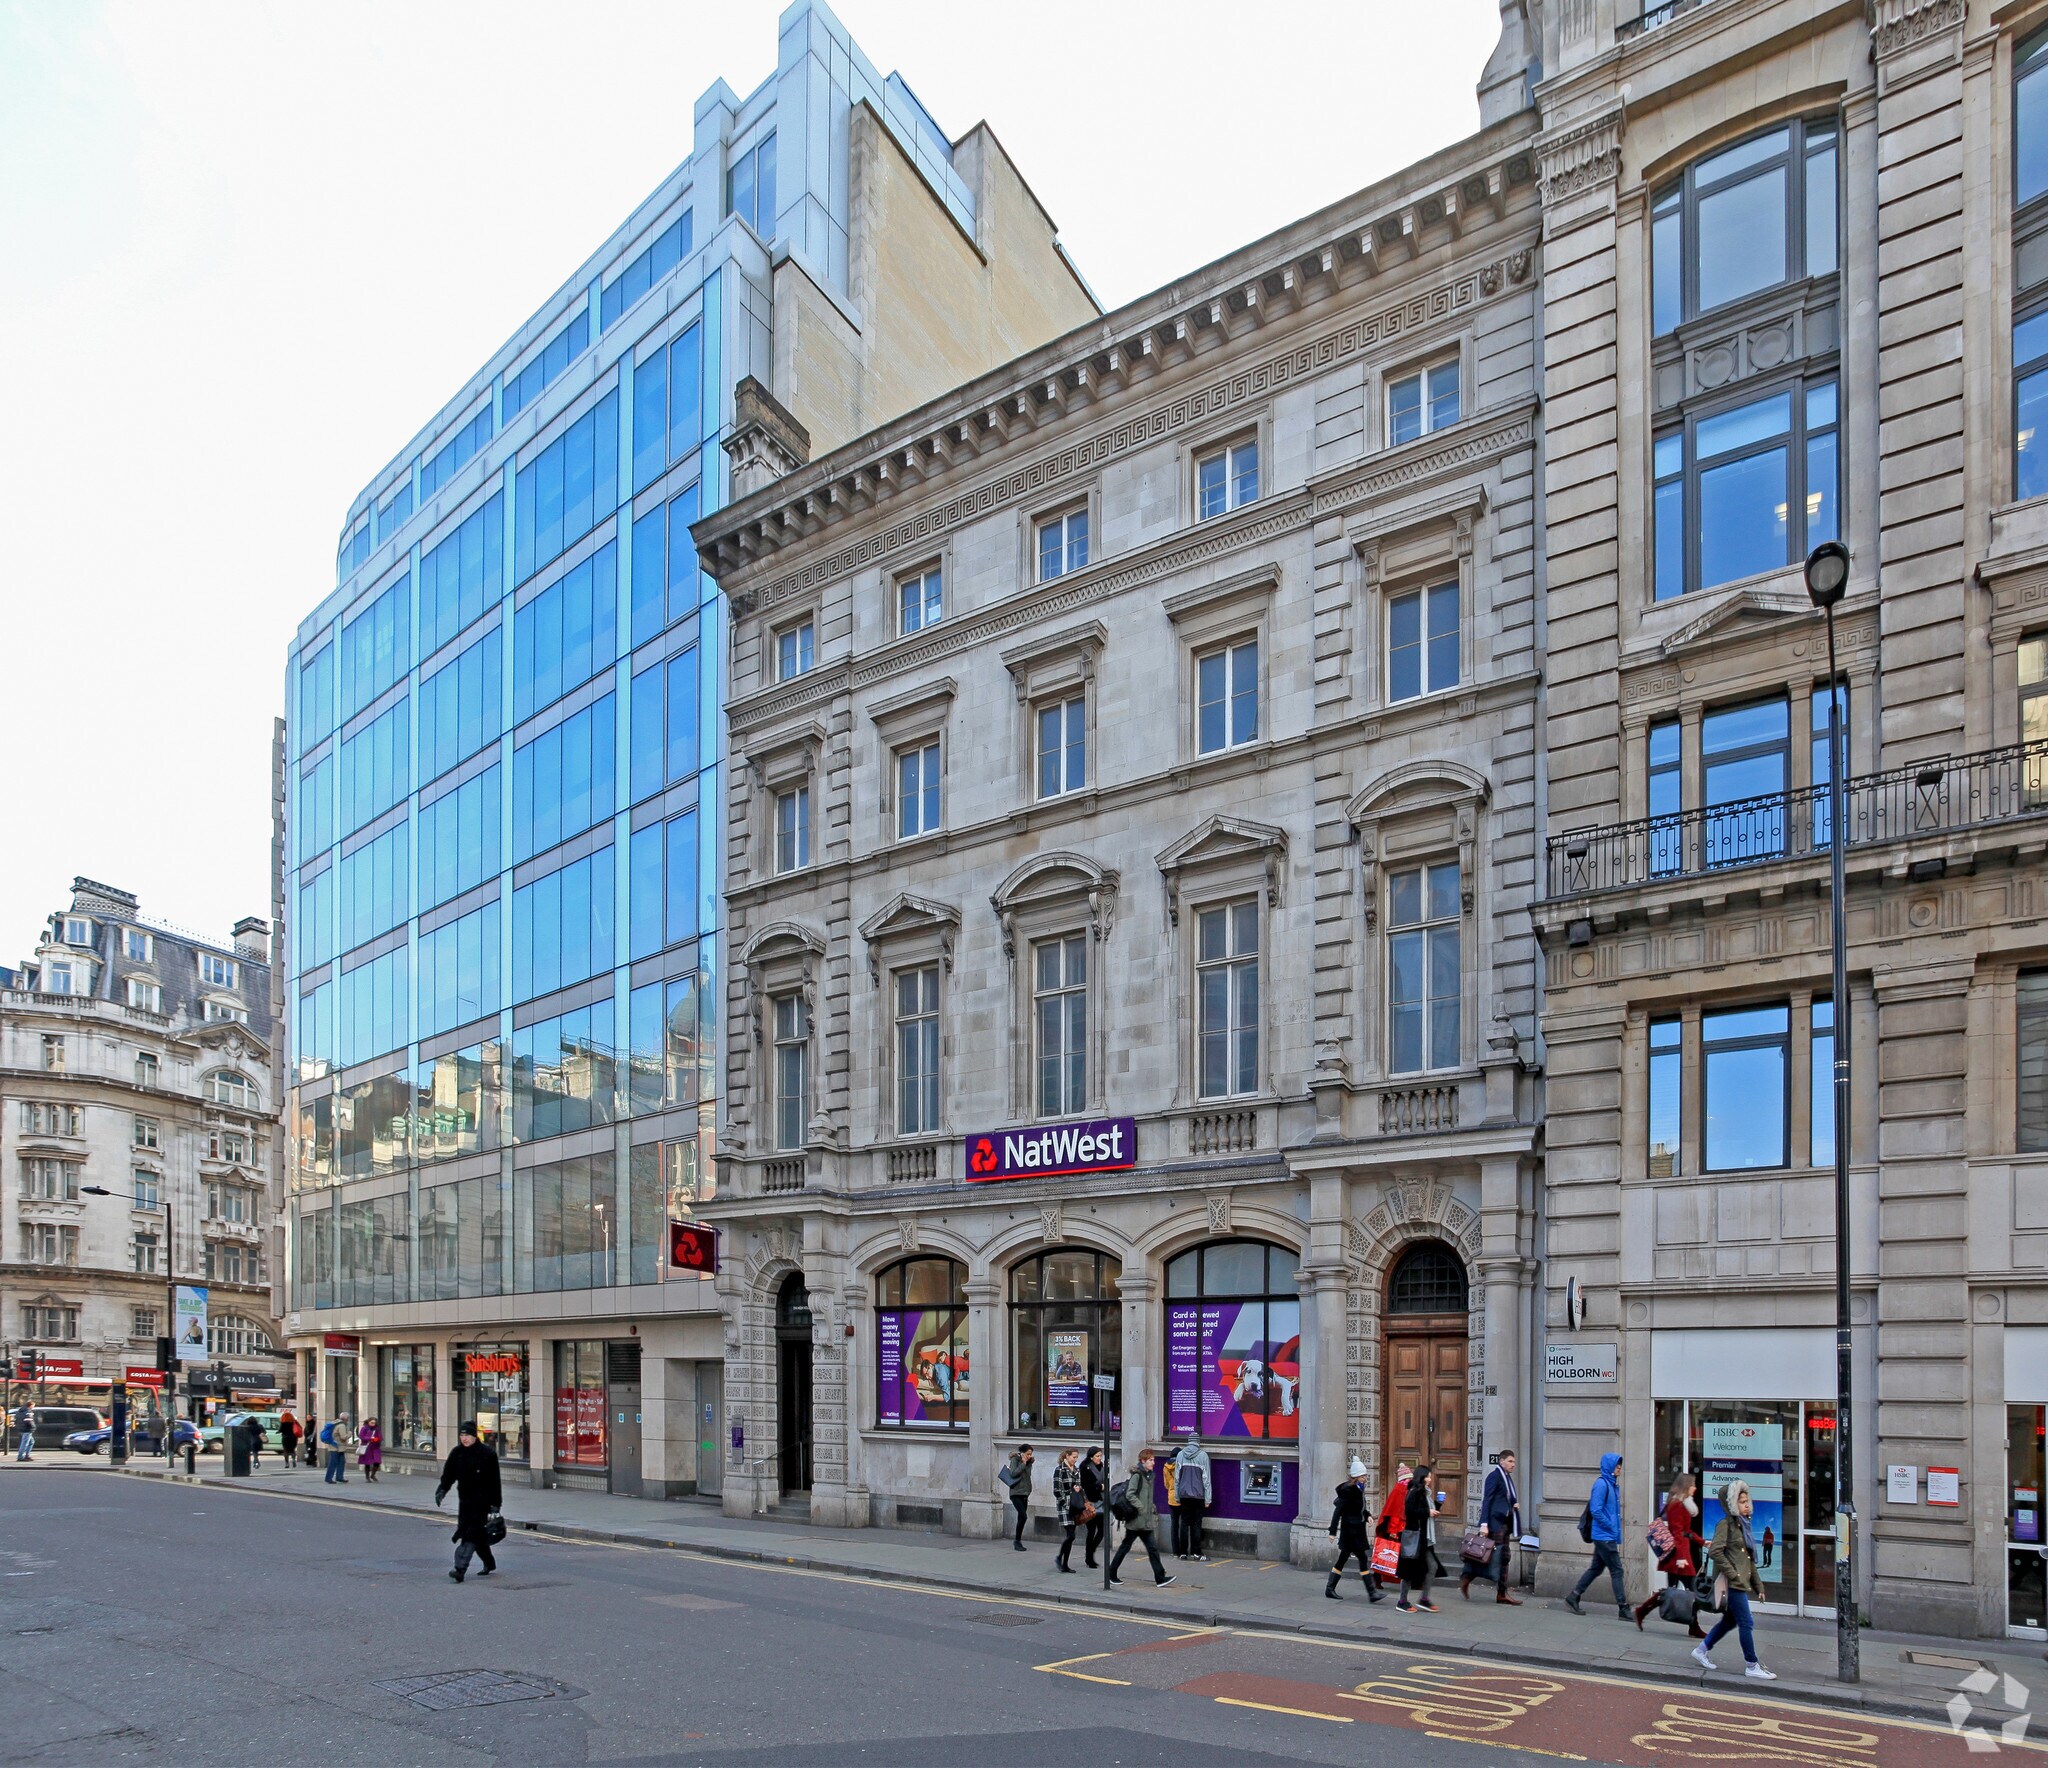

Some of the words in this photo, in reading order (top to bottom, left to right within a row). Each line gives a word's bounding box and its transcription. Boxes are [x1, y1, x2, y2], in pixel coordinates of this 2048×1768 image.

[1004, 1123, 1123, 1169] NatWest
[465, 1353, 520, 1376] Sainsbury's
[1548, 1356, 1574, 1365] HIGH
[1548, 1369, 1600, 1378] HOLBORN
[494, 1373, 520, 1392] Local
[1713, 1428, 1739, 1437] HSBC
[1713, 1443, 1747, 1451] Welcome
[1490, 1455, 1500, 1464] 21
